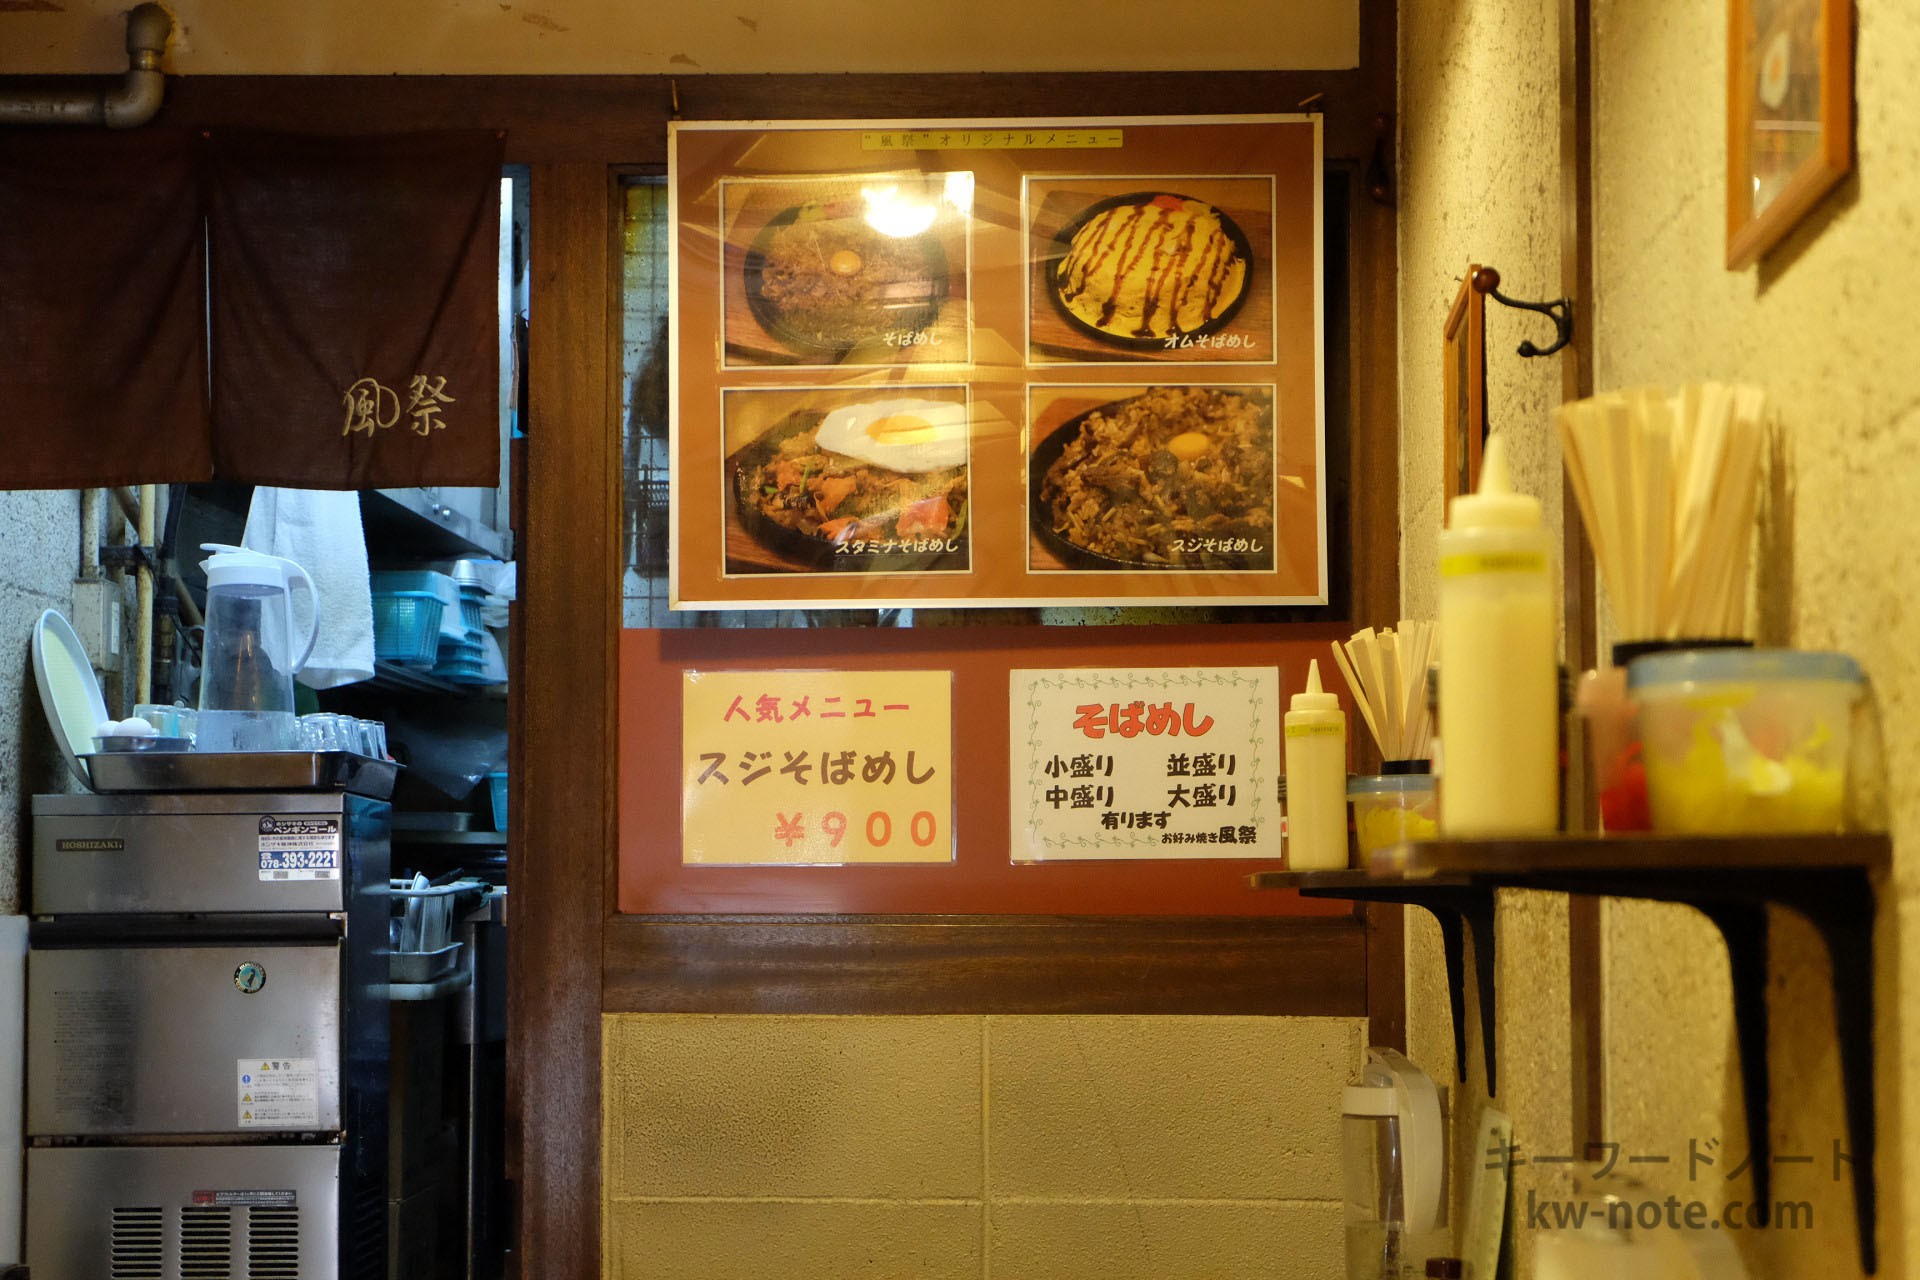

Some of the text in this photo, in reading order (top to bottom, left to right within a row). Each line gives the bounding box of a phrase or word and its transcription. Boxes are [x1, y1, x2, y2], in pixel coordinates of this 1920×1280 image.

[883, 331, 943, 346] そばめし
[1164, 333, 1257, 349] オムそばめし
[342, 375, 456, 437] 風祭
[835, 538, 958, 554] スタミナそばめし
[1171, 537, 1263, 552] スジそばめし
[723, 694, 910, 723] 人気メニュー
[1073, 701, 1214, 739] そばめし
[697, 750, 936, 786] スジそばめし
[1044, 753, 1114, 778] 小盛り
[1166, 752, 1236, 777] 並盛り
[1045, 784, 1114, 809] 中盛り
[1167, 783, 1236, 808] 大盛り
[273, 825, 337, 834] ペンギンコール
[1101, 811, 1172, 830] 有ります
[62, 841, 119, 849] HOSHIZAKI
[1161, 825, 1257, 844] お好み焼き風祭
